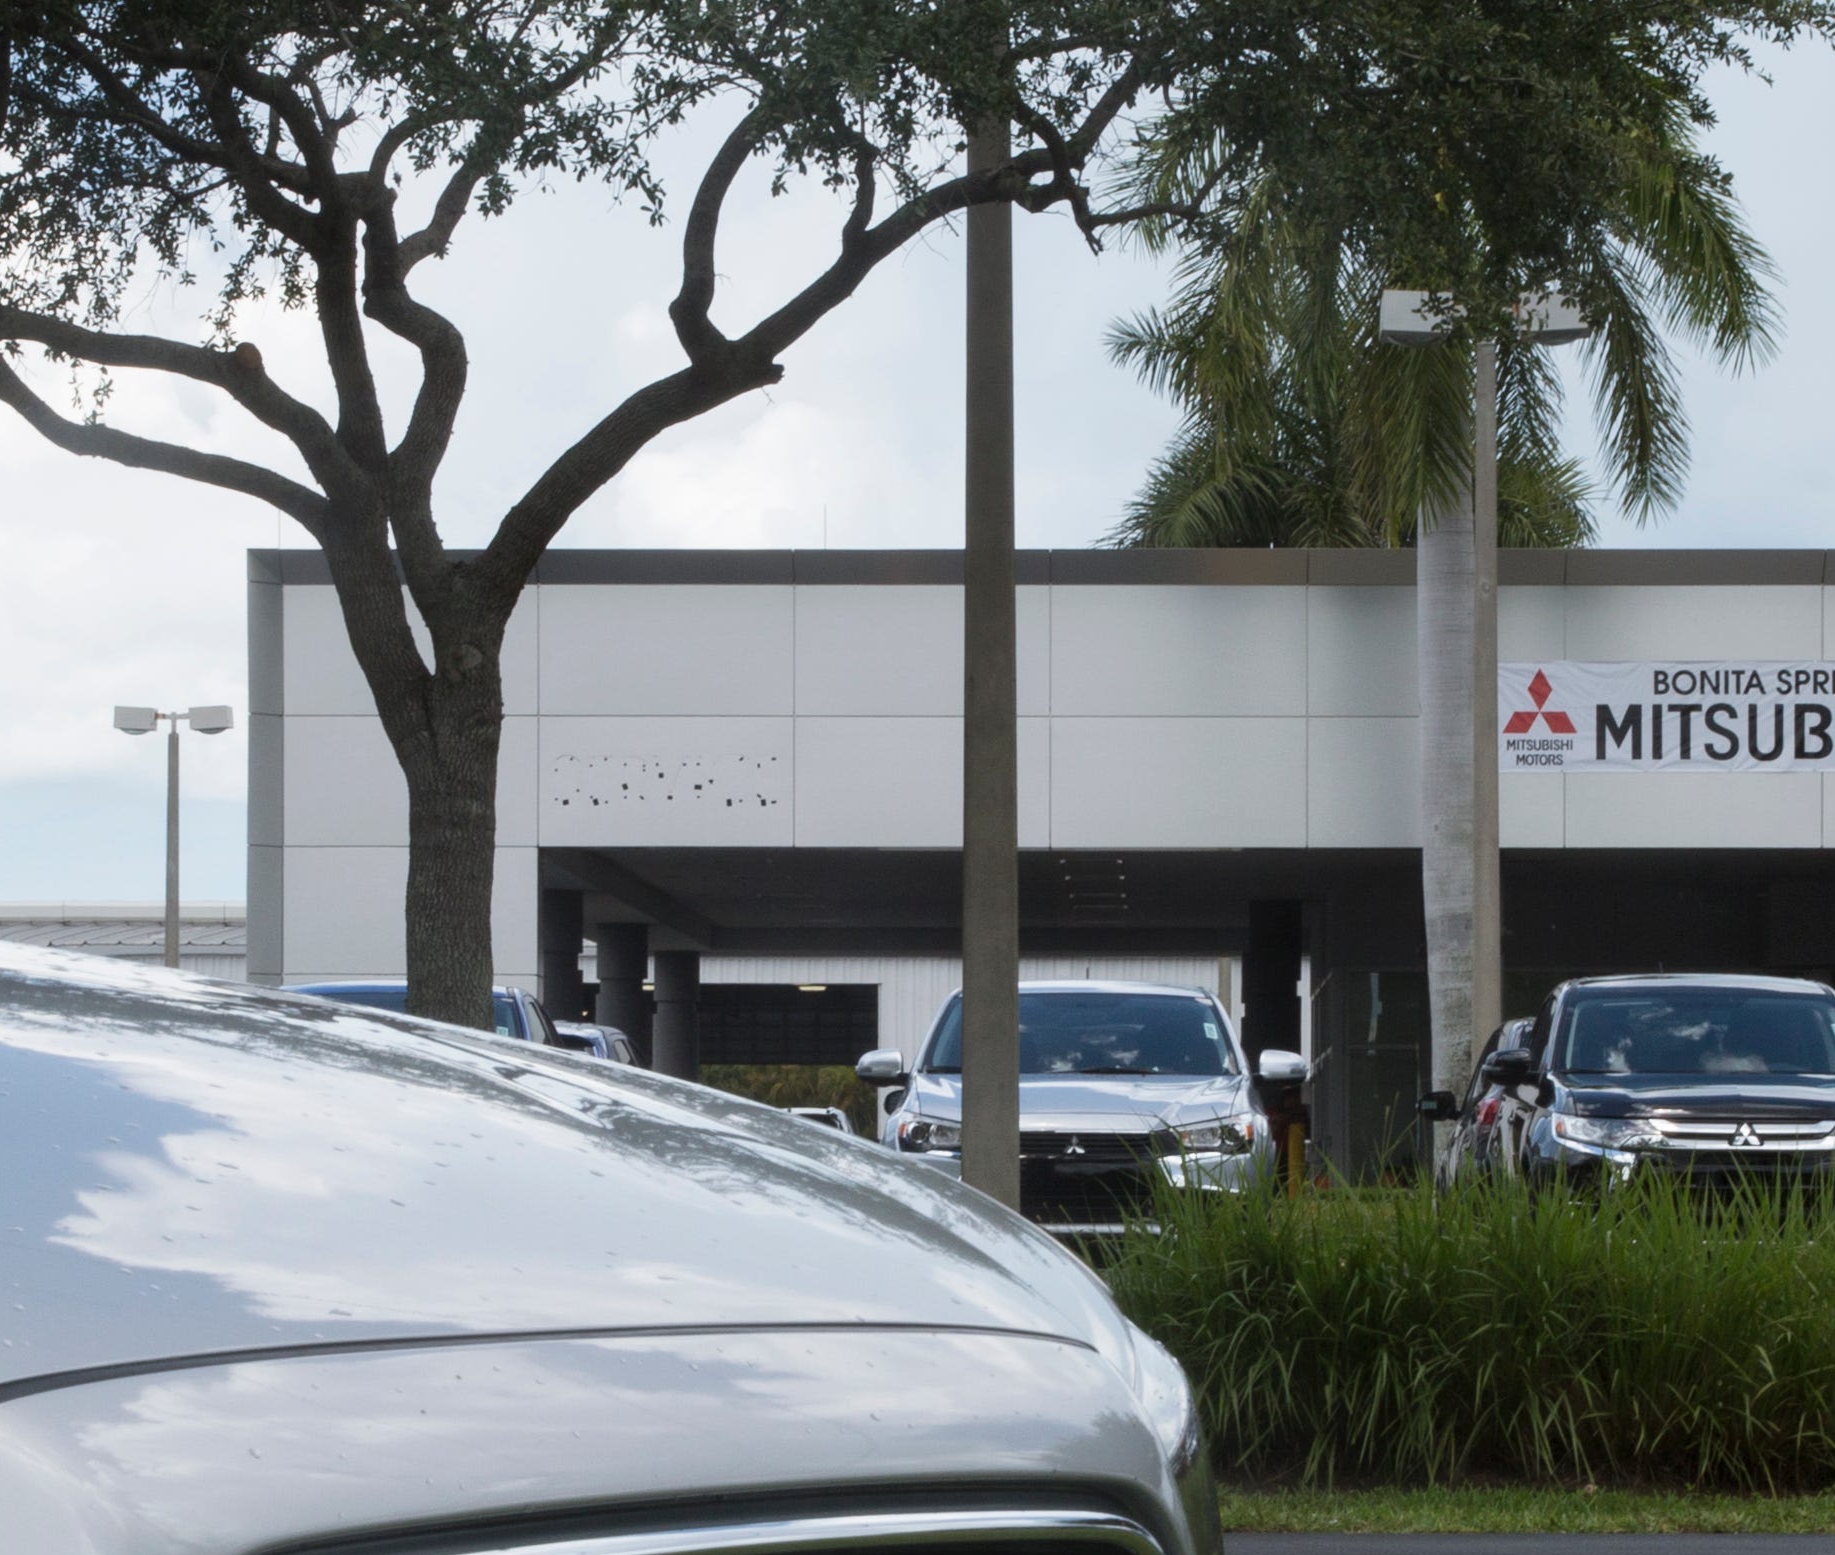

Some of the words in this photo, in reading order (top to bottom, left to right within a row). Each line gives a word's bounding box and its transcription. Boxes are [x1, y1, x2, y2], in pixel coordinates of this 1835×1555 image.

[1653, 669, 1766, 696] BONITA
[1506, 738, 1574, 752] MITSUBISHI
[1516, 753, 1564, 766] MOTORS
